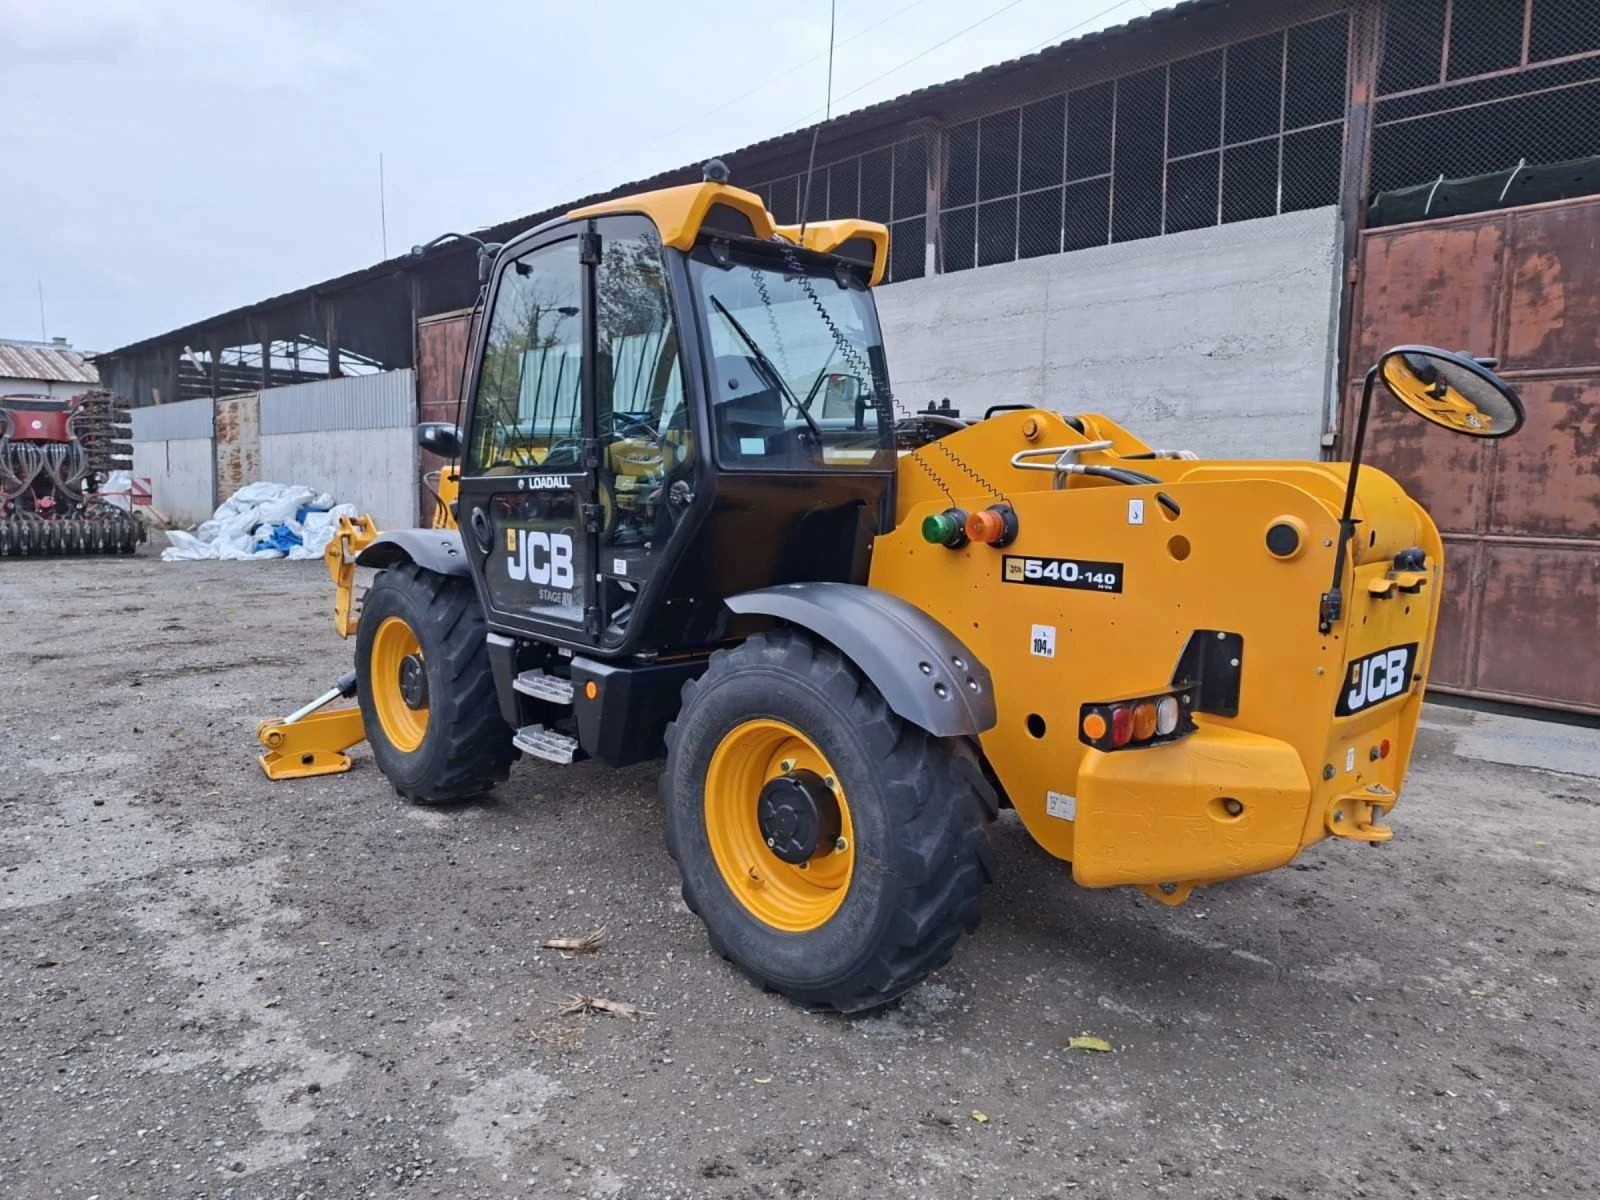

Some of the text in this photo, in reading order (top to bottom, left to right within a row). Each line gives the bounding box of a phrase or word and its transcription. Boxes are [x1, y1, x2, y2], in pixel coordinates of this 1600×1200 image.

[528, 476, 572, 489] LOADALL
[507, 529, 574, 589] JCB
[1024, 559, 1116, 585] 540-140
[538, 589, 562, 603] STAGE
[1033, 638, 1047, 655] 104
[1347, 648, 1409, 710] JCB
